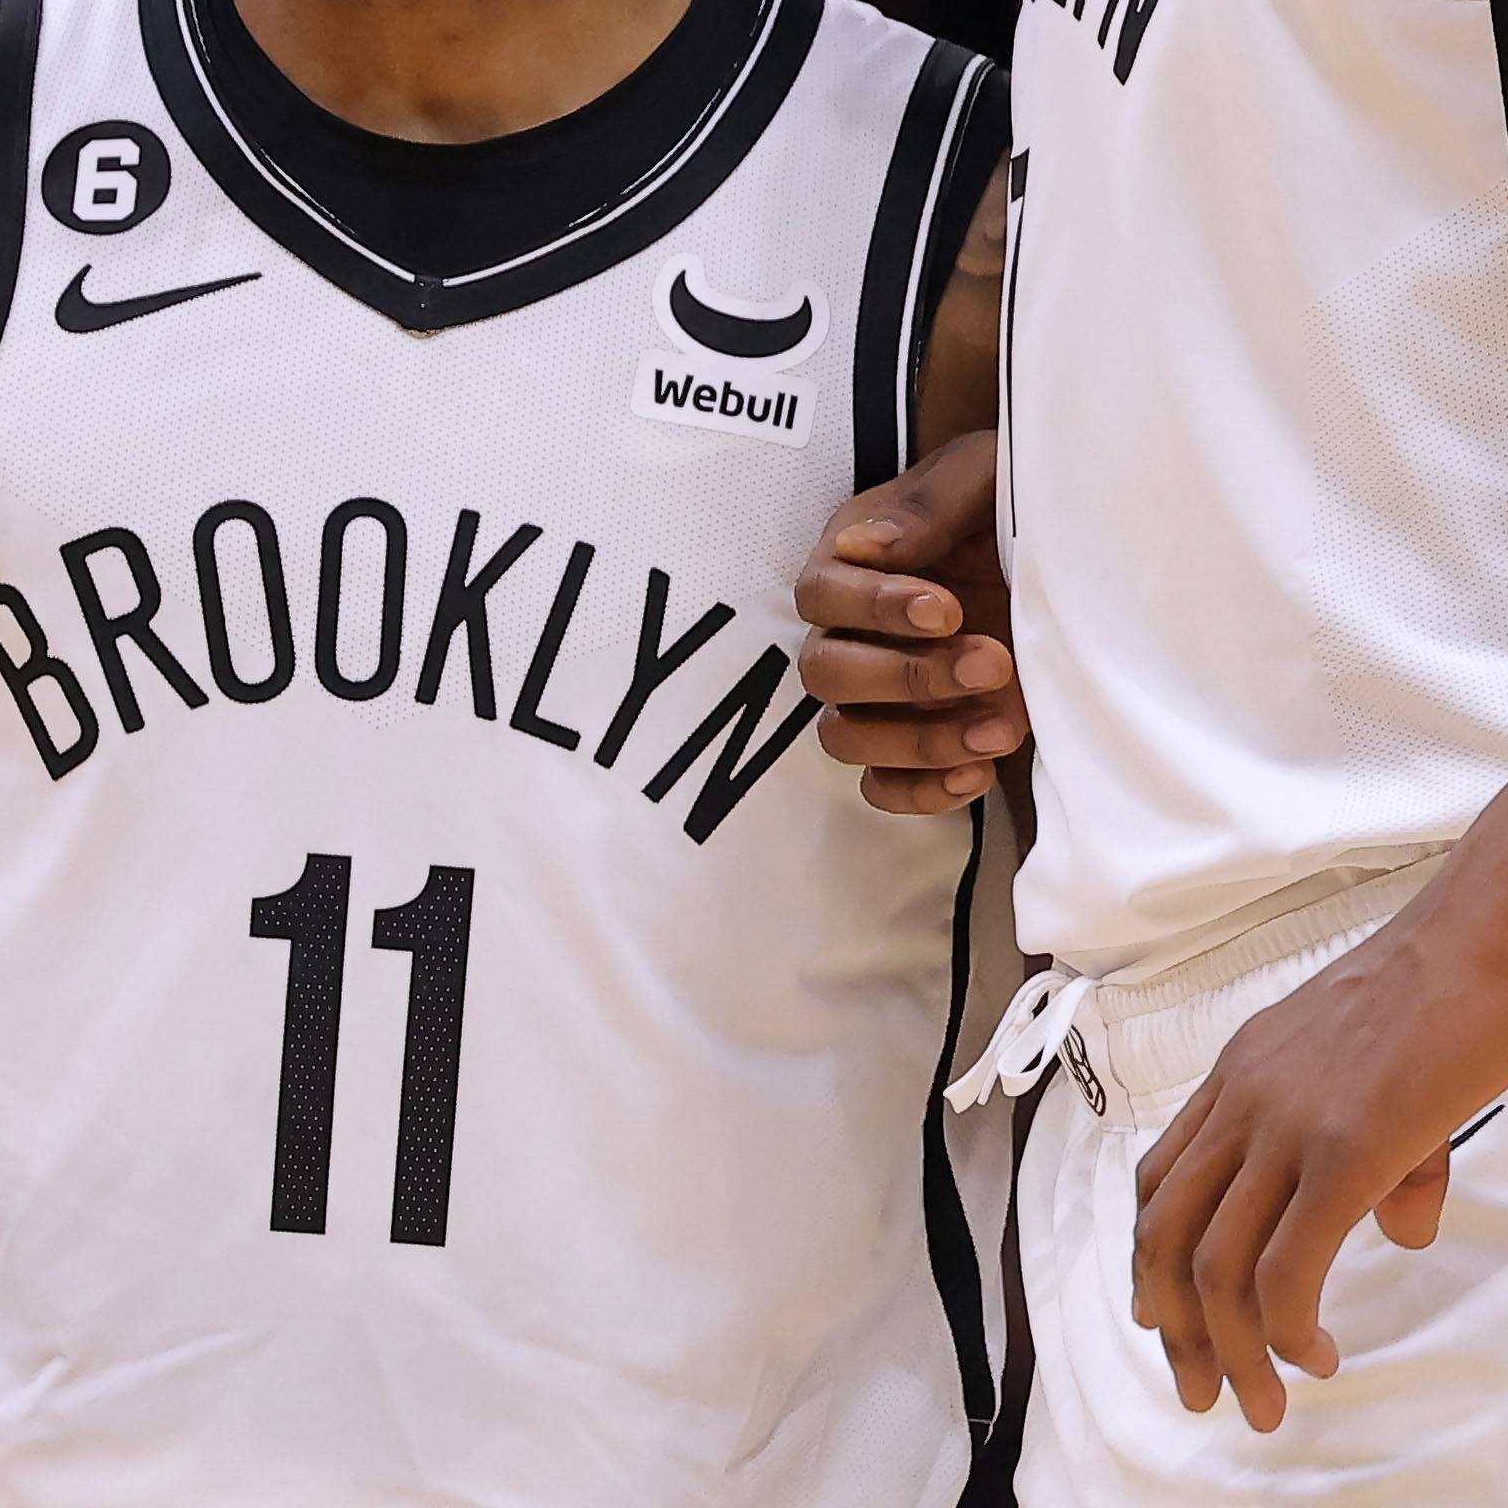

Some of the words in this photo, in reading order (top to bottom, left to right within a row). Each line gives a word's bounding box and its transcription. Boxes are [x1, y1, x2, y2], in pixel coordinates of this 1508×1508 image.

[71, 136, 143, 223] 6
[652, 368, 799, 431] Webull
[249, 852, 475, 1248] 11
